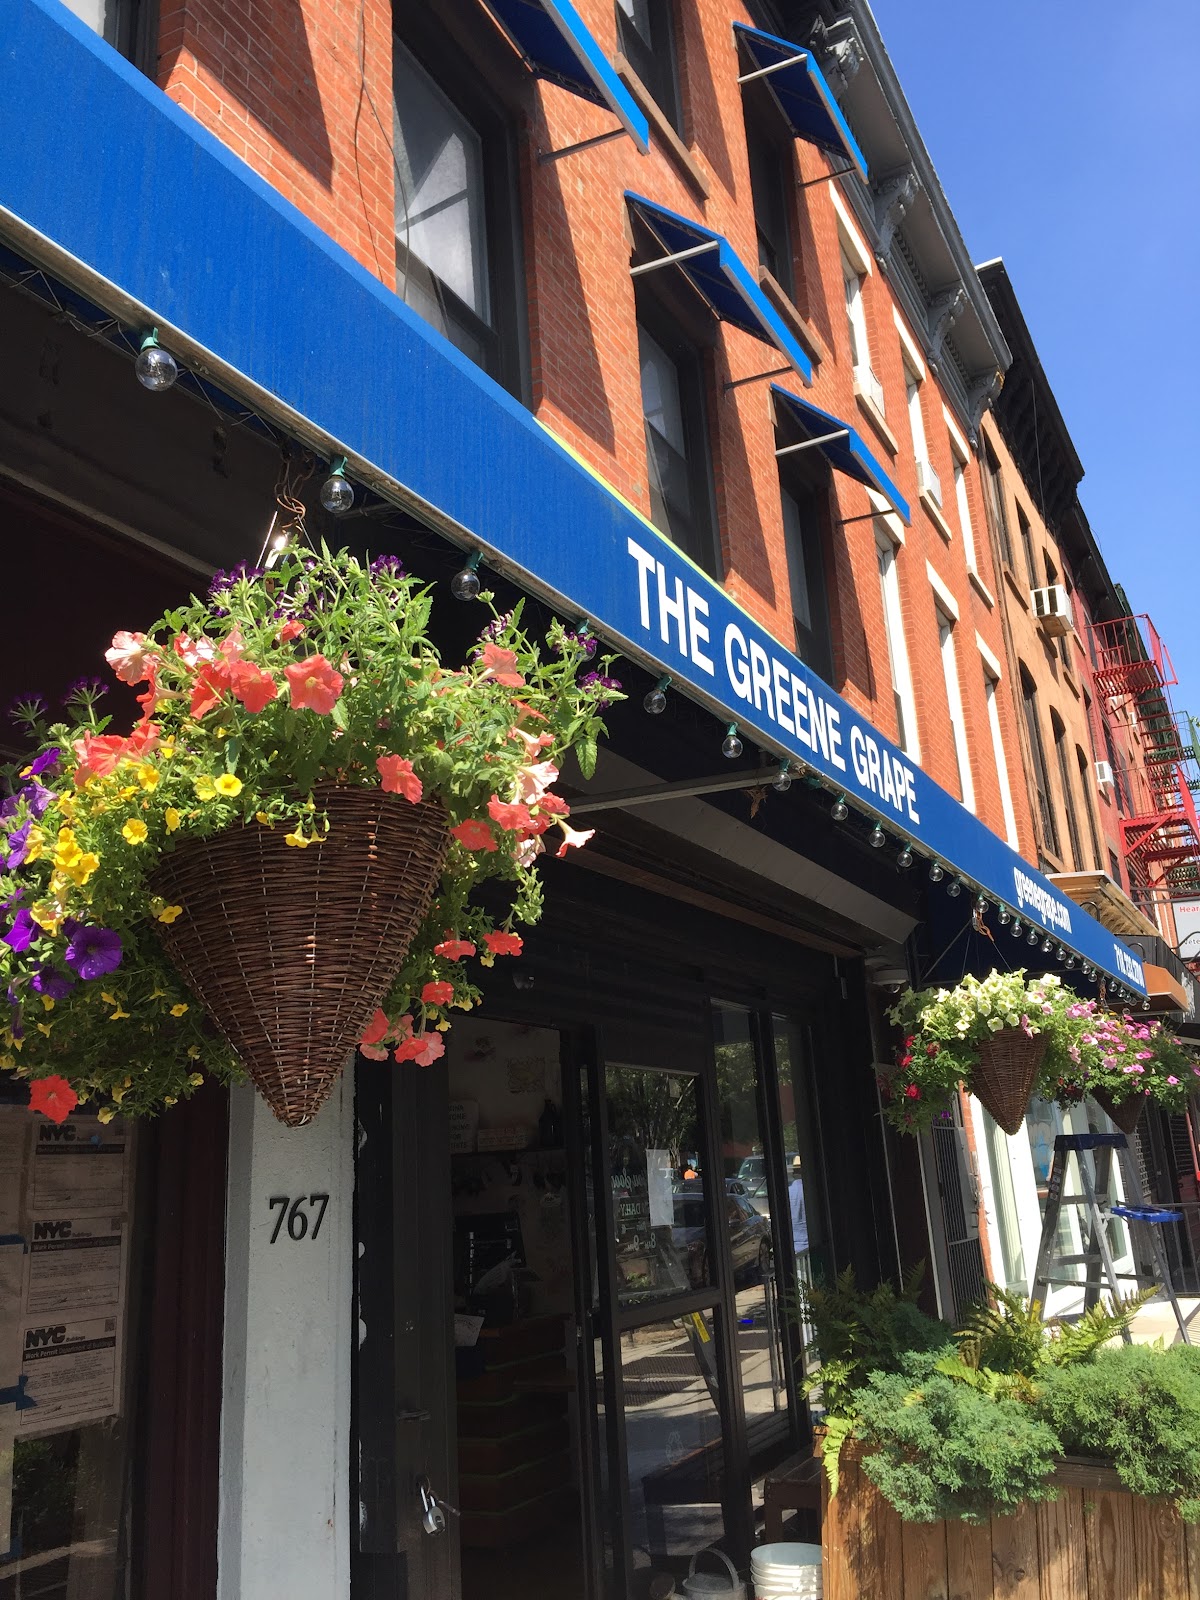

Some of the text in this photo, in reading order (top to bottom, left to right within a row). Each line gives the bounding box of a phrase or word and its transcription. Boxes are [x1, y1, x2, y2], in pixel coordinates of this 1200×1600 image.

[627, 537, 920, 825] THE GREENE GRAPE
[40, 1125, 76, 1141] NYC
[269, 1194, 329, 1244] 767
[34, 1220, 72, 1240] NYC
[26, 1326, 66, 1348] NYC
[26, 1352, 39, 1360] Work
[40, 1349, 57, 1358] Permit
